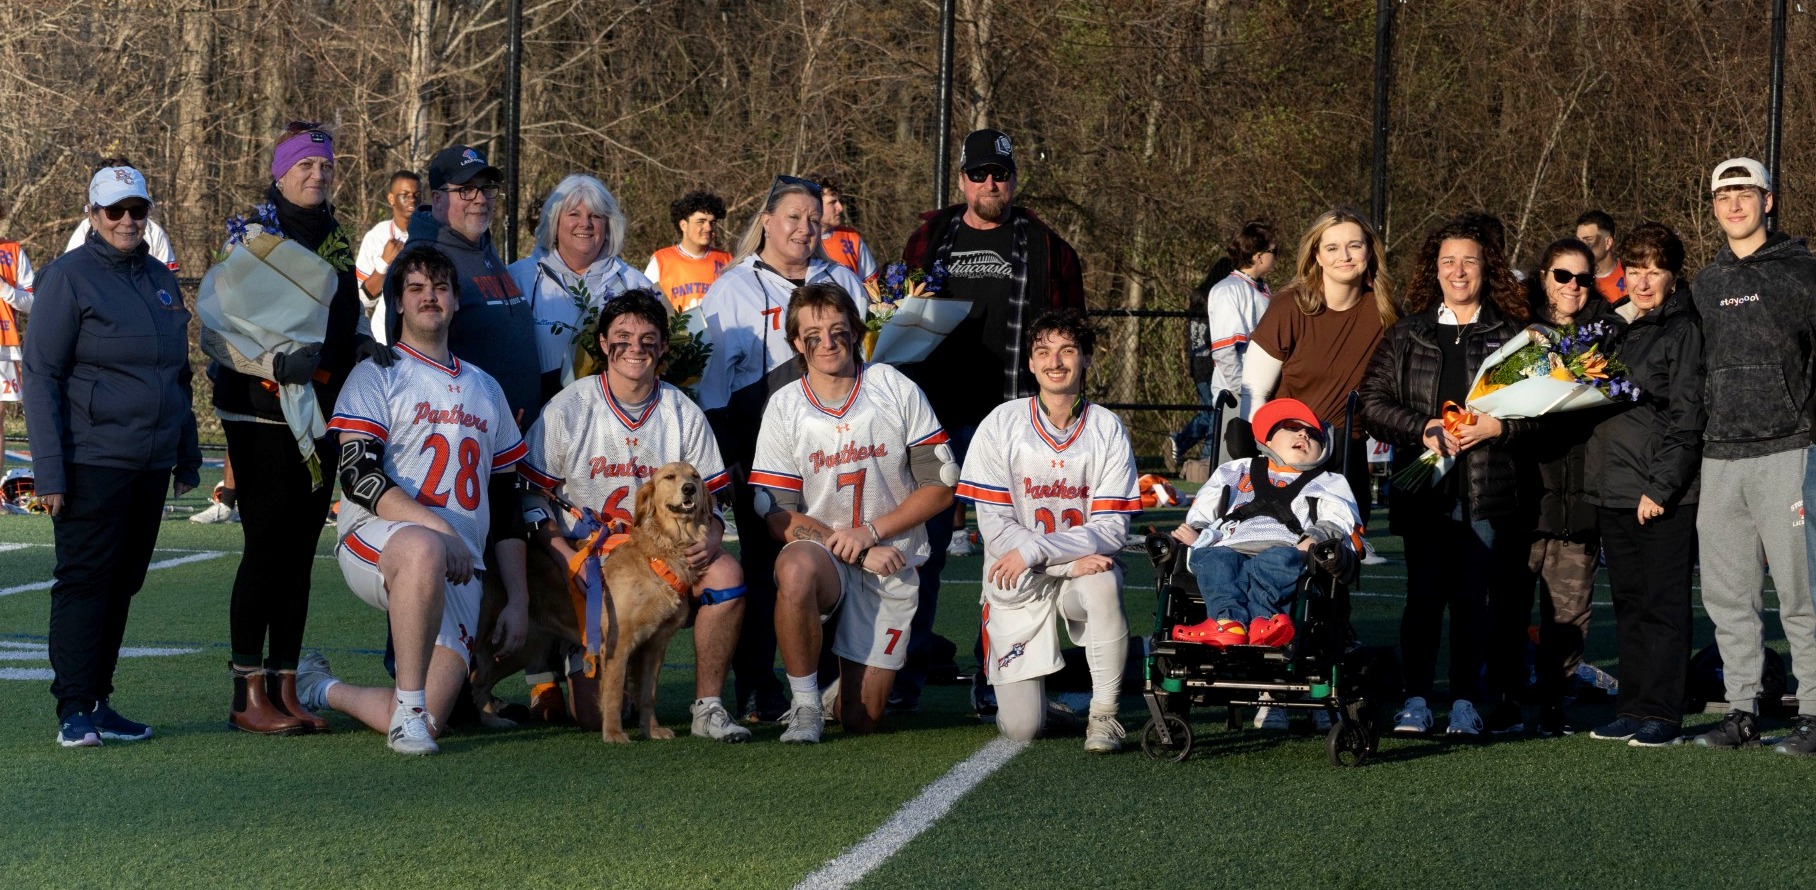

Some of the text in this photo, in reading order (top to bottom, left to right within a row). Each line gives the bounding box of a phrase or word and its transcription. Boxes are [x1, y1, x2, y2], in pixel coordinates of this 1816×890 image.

[948, 260, 1012, 276] tracoasta
[1720, 293, 1759, 306] staycool
[761, 306, 782, 330] 7
[413, 401, 488, 433] Panthers
[415, 433, 481, 511] 28
[836, 468, 867, 528] 7
[884, 628, 902, 655] 7
